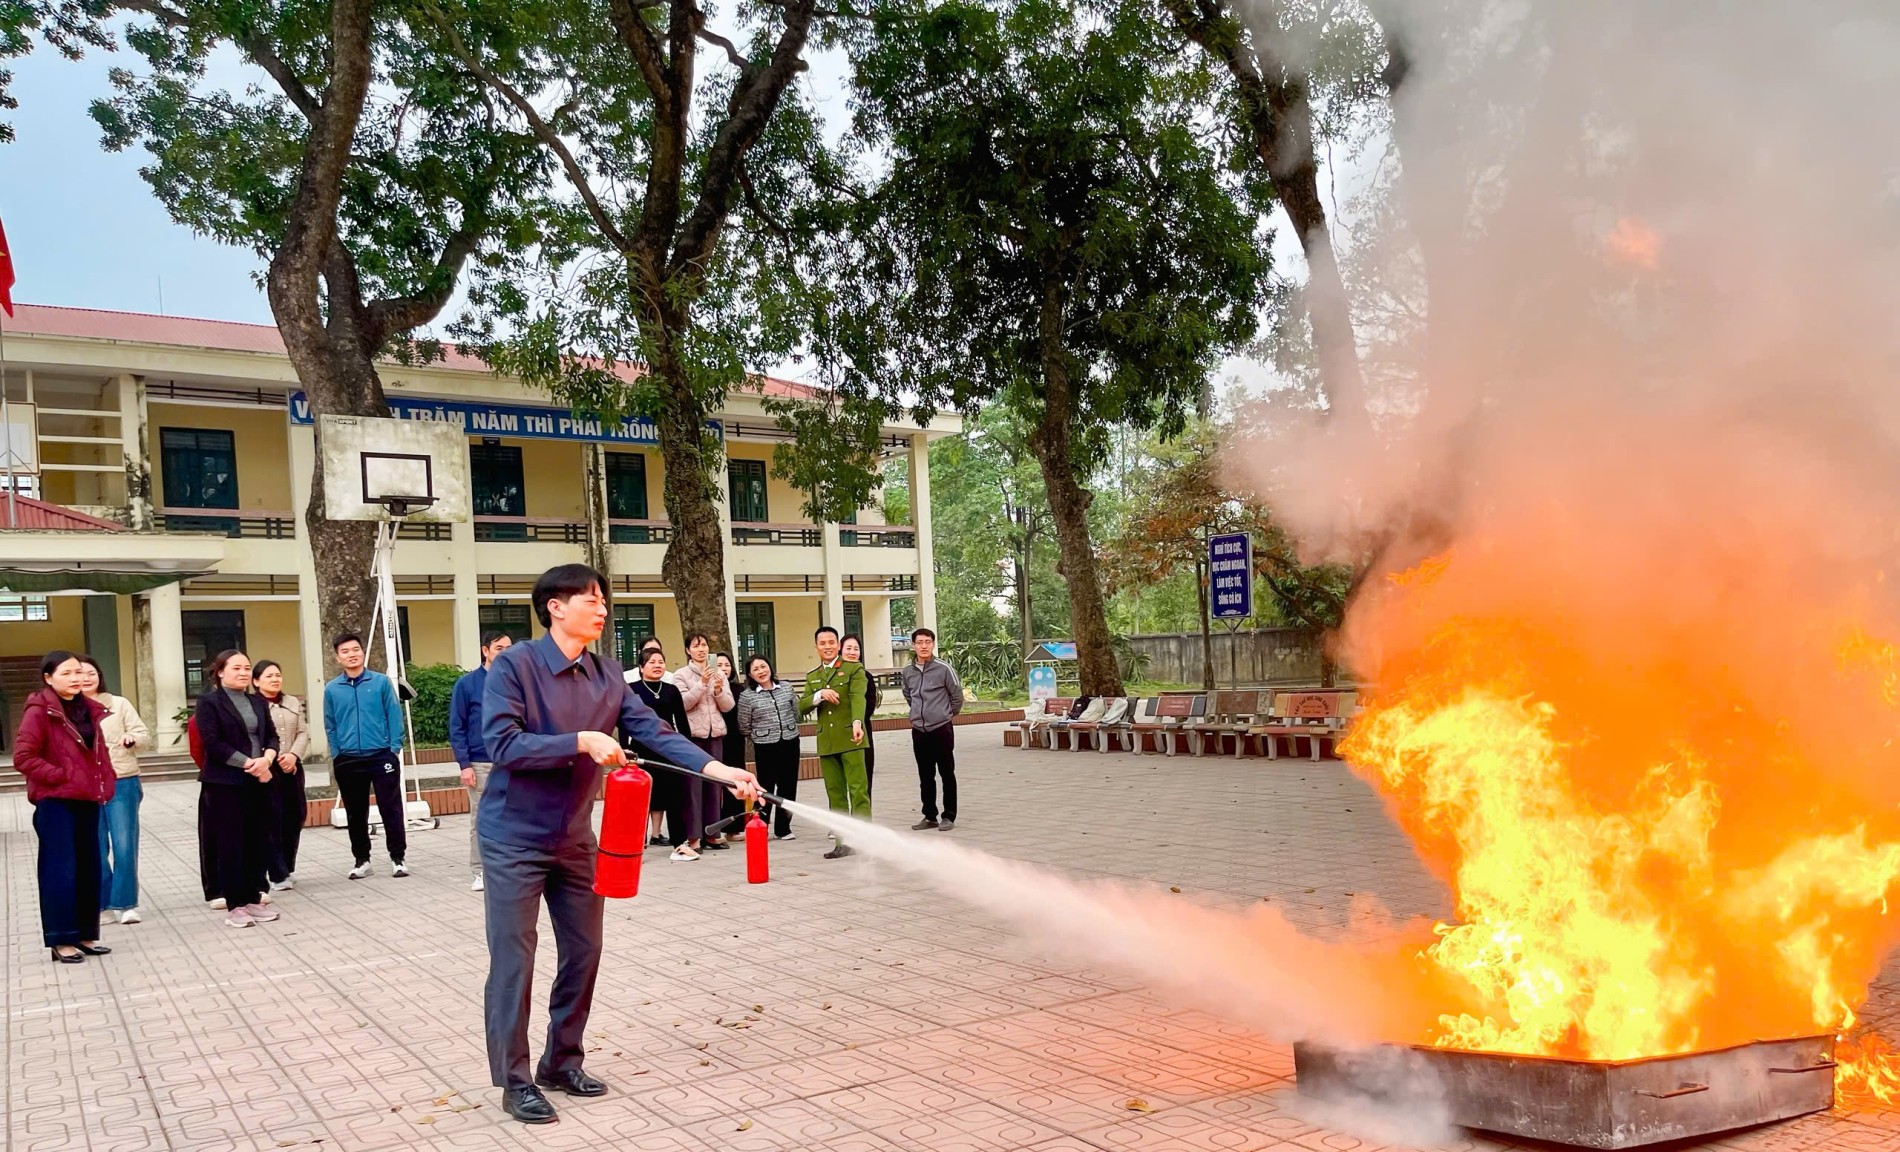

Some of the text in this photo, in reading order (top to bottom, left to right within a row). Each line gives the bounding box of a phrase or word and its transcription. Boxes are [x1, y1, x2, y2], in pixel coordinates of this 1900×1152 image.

[295, 400, 314, 419] V
[472, 409, 519, 431] NĂM
[524, 413, 554, 434] THÌ
[1212, 561, 1220, 574] HỌC
[1216, 575, 1225, 589] LÀM
[1225, 574, 1234, 590] VIỆC
[1218, 591, 1242, 605] SỐNG CÓ ÍCH
